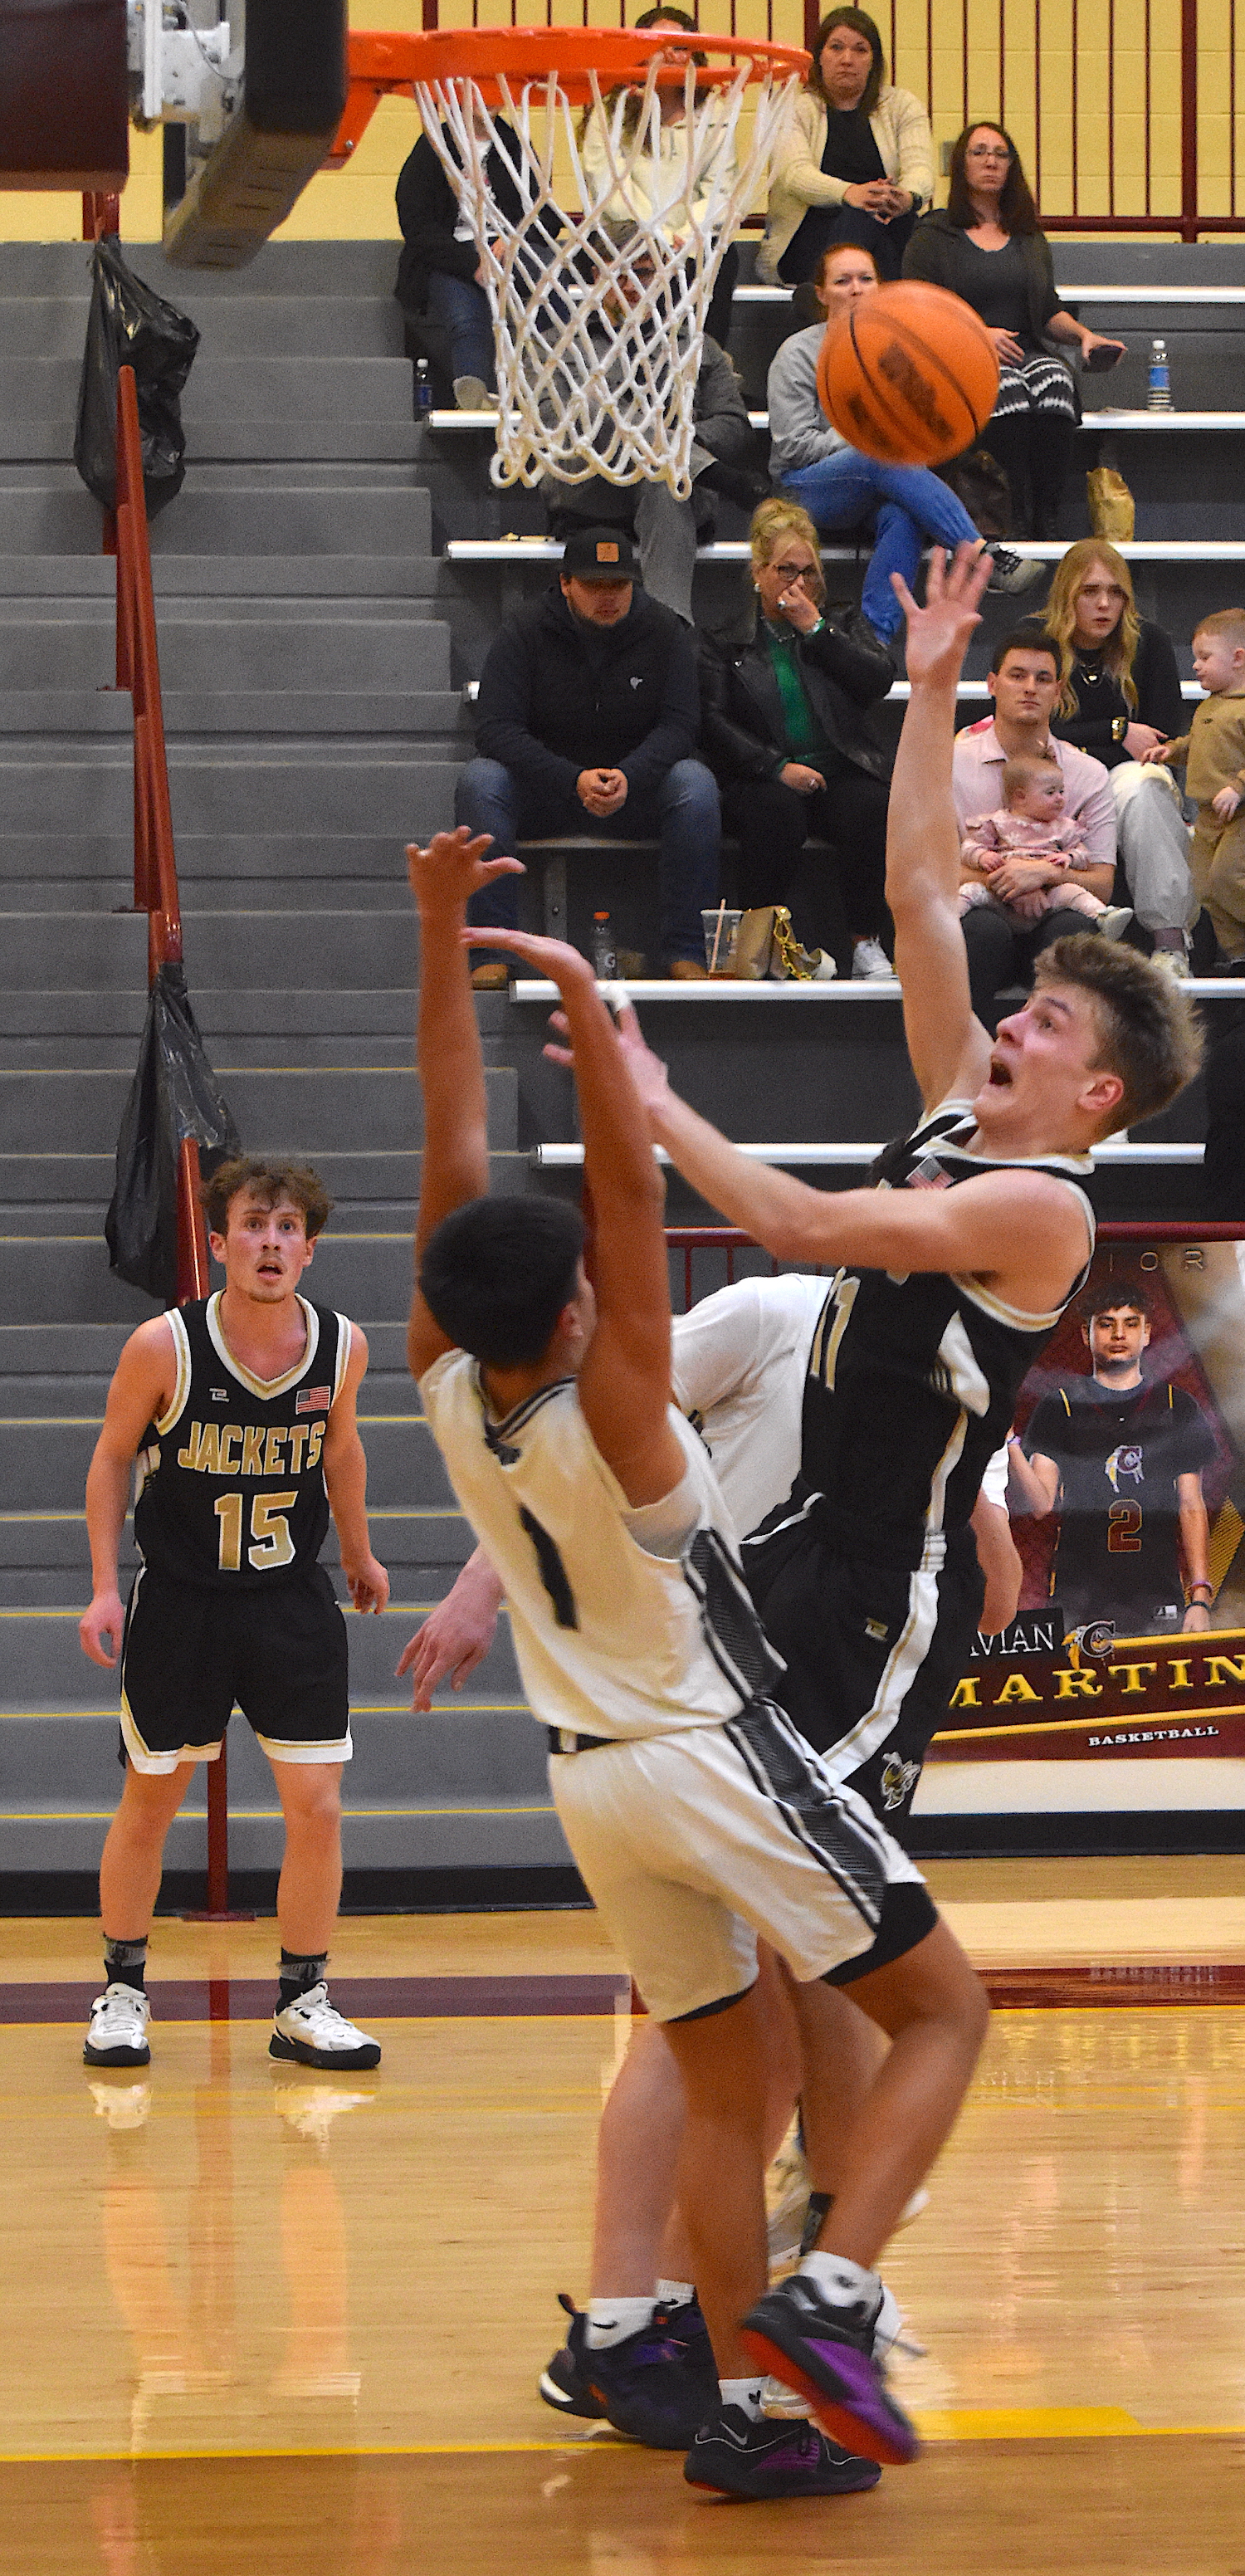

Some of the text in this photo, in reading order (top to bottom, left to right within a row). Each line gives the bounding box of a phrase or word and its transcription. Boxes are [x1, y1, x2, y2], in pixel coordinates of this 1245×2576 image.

[1108, 1249, 1204, 1273] IOR
[178, 1420, 326, 1476] JACKETS
[214, 1491, 299, 1571] 15
[1107, 1498, 1143, 1552] 2
[969, 1621, 1055, 1657] VIAN
[1088, 1725, 1219, 1747] BASKETBALL
